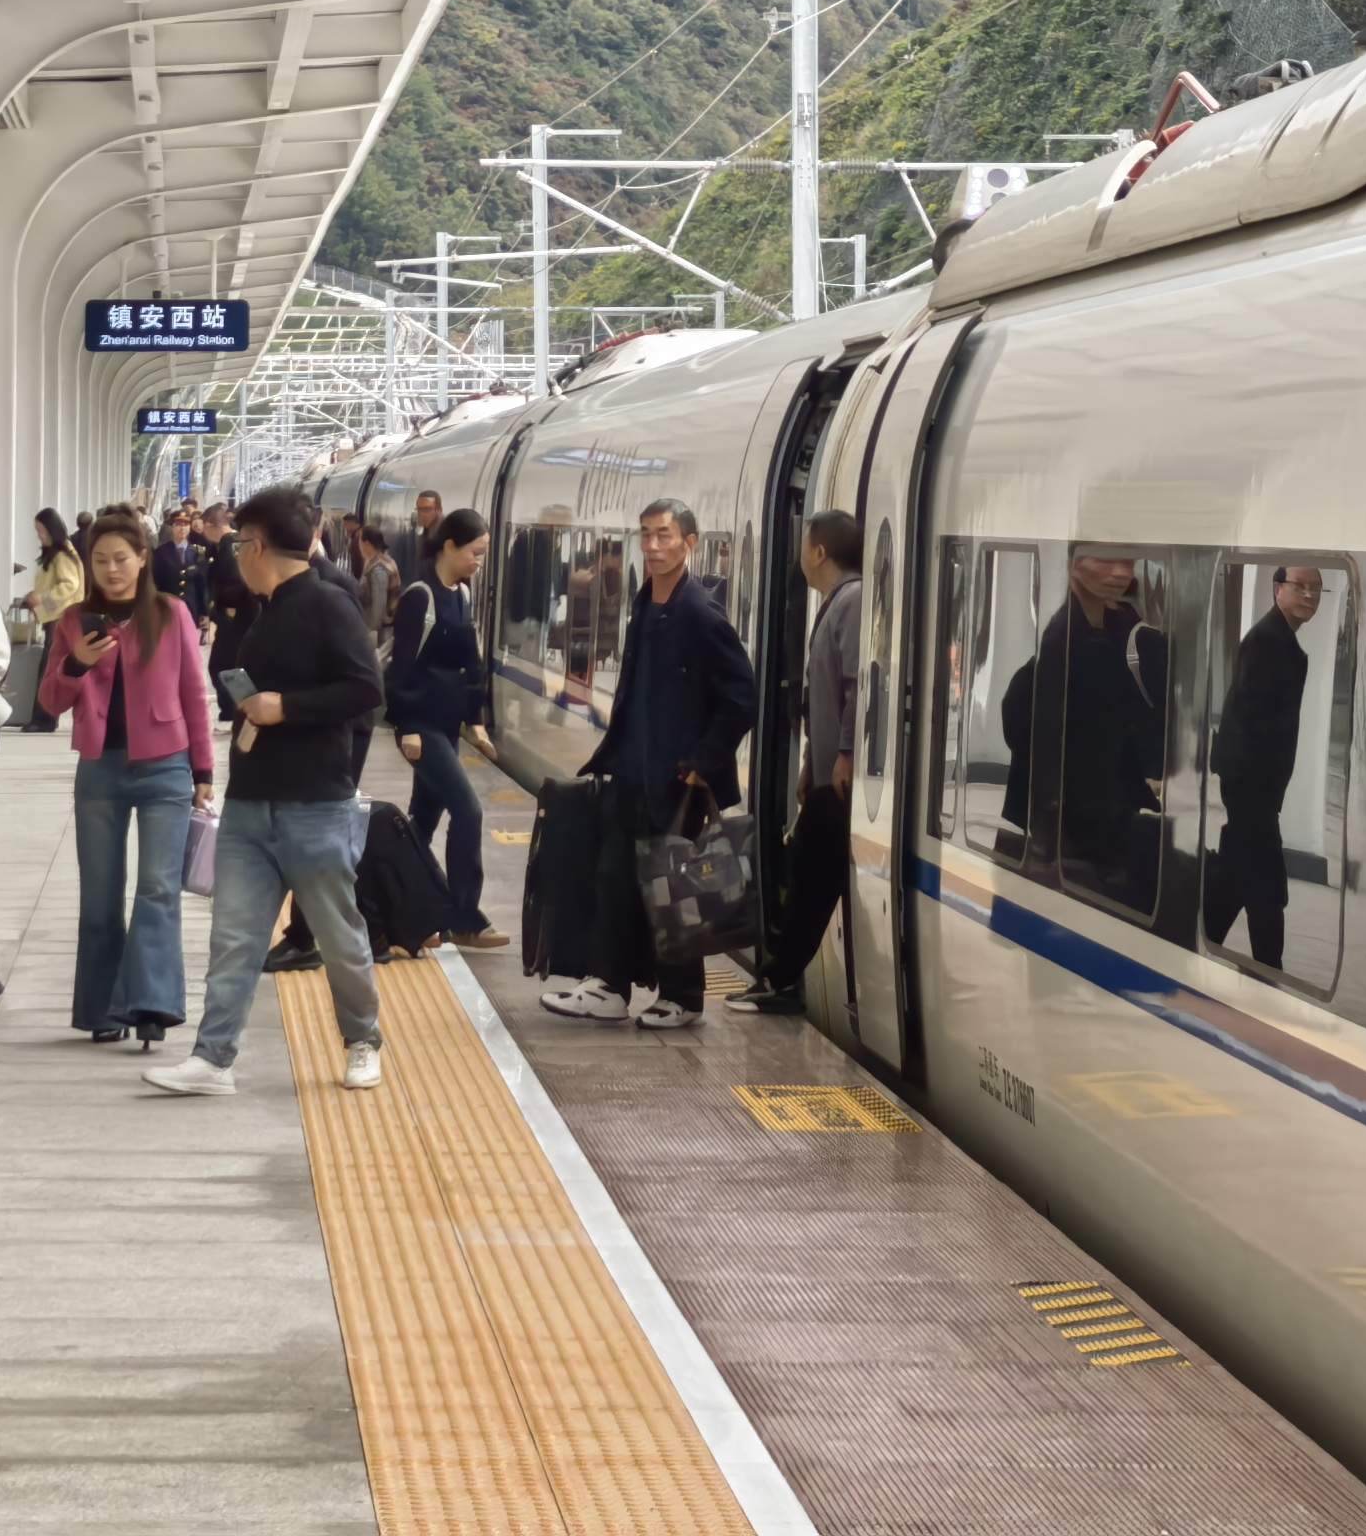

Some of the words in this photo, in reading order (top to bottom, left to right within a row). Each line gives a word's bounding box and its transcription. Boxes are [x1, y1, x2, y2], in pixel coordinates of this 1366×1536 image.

[108, 304, 226, 329] 镇安西站
[153, 334, 195, 347] Railway
[197, 334, 235, 345] Station
